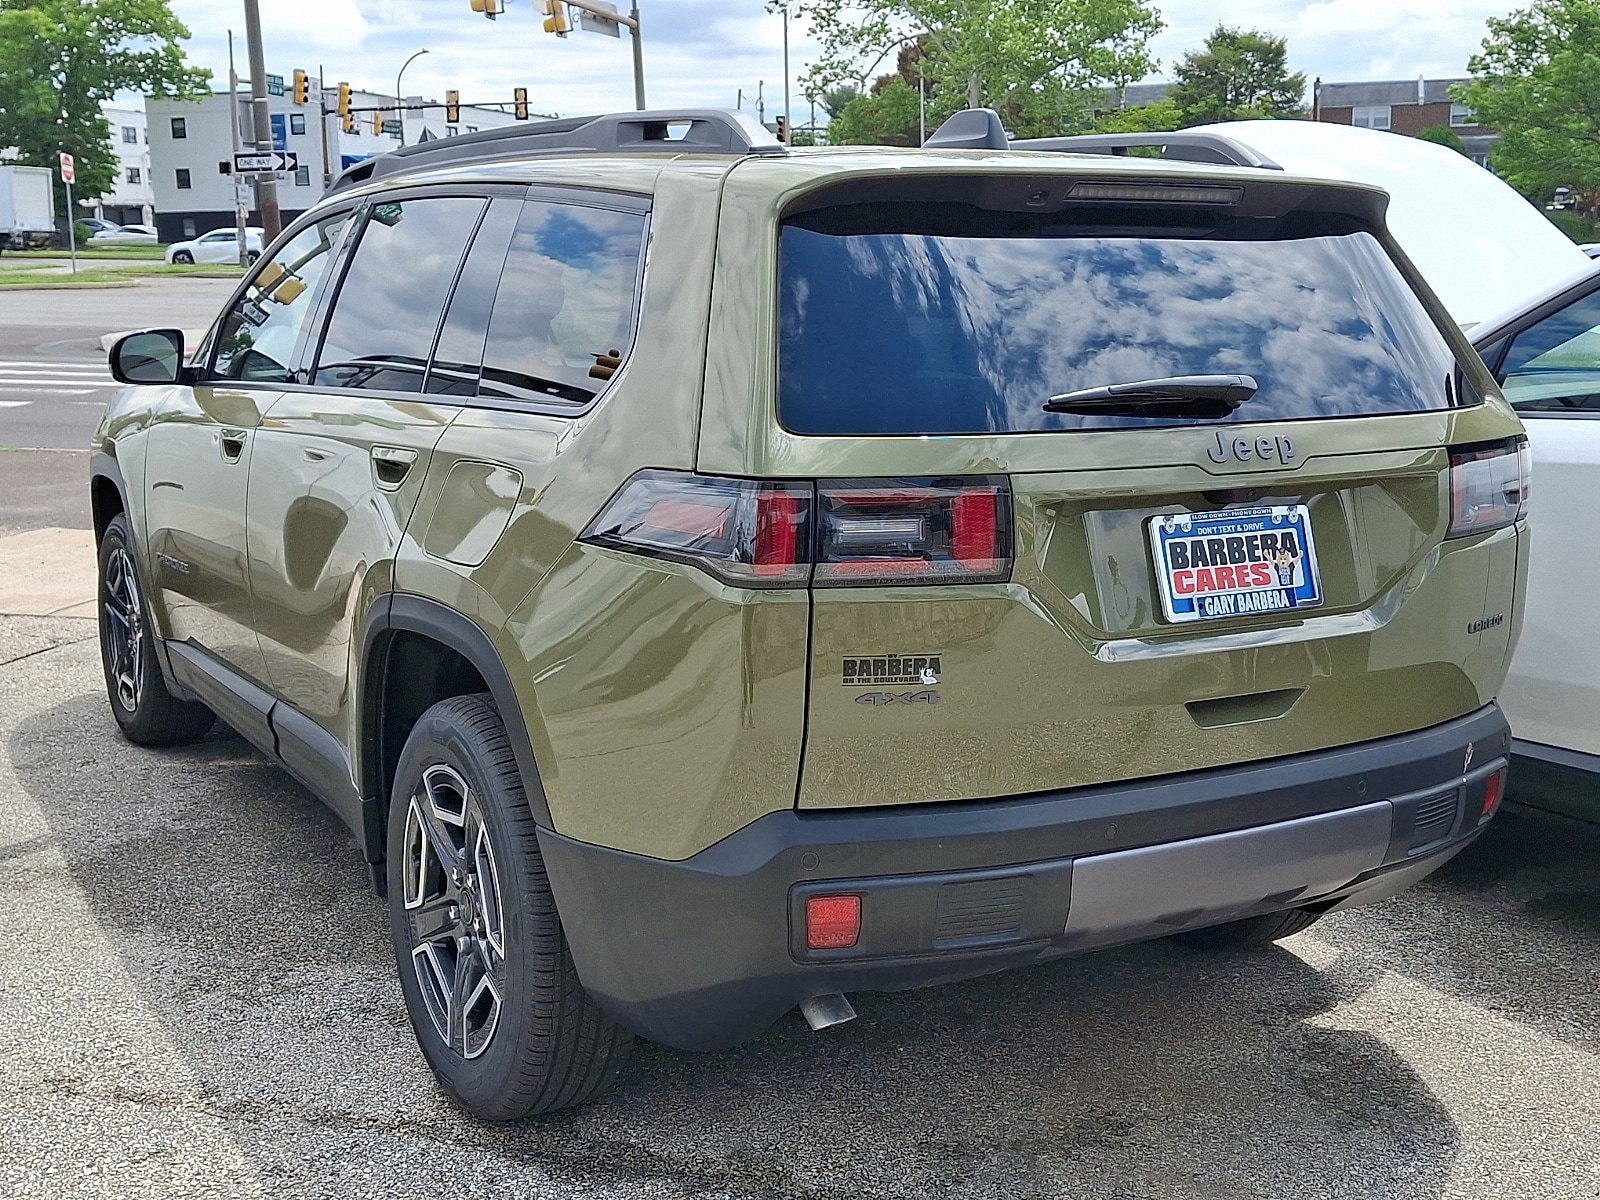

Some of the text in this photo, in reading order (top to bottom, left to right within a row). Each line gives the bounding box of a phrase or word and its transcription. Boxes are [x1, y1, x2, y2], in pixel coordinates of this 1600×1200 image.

[256, 158, 271, 166] WAY
[1207, 432, 1297, 464] Jeep
[1197, 526, 1217, 535] DON'T
[1218, 525, 1236, 533] TEXT
[1242, 522, 1265, 531] DRIVE
[1168, 532, 1299, 570] BARBERA
[1173, 563, 1271, 595] CARES
[1204, 590, 1290, 616] GARY BARBERA
[1467, 613, 1503, 634] LAREDO
[843, 658, 942, 677] BARBERA
